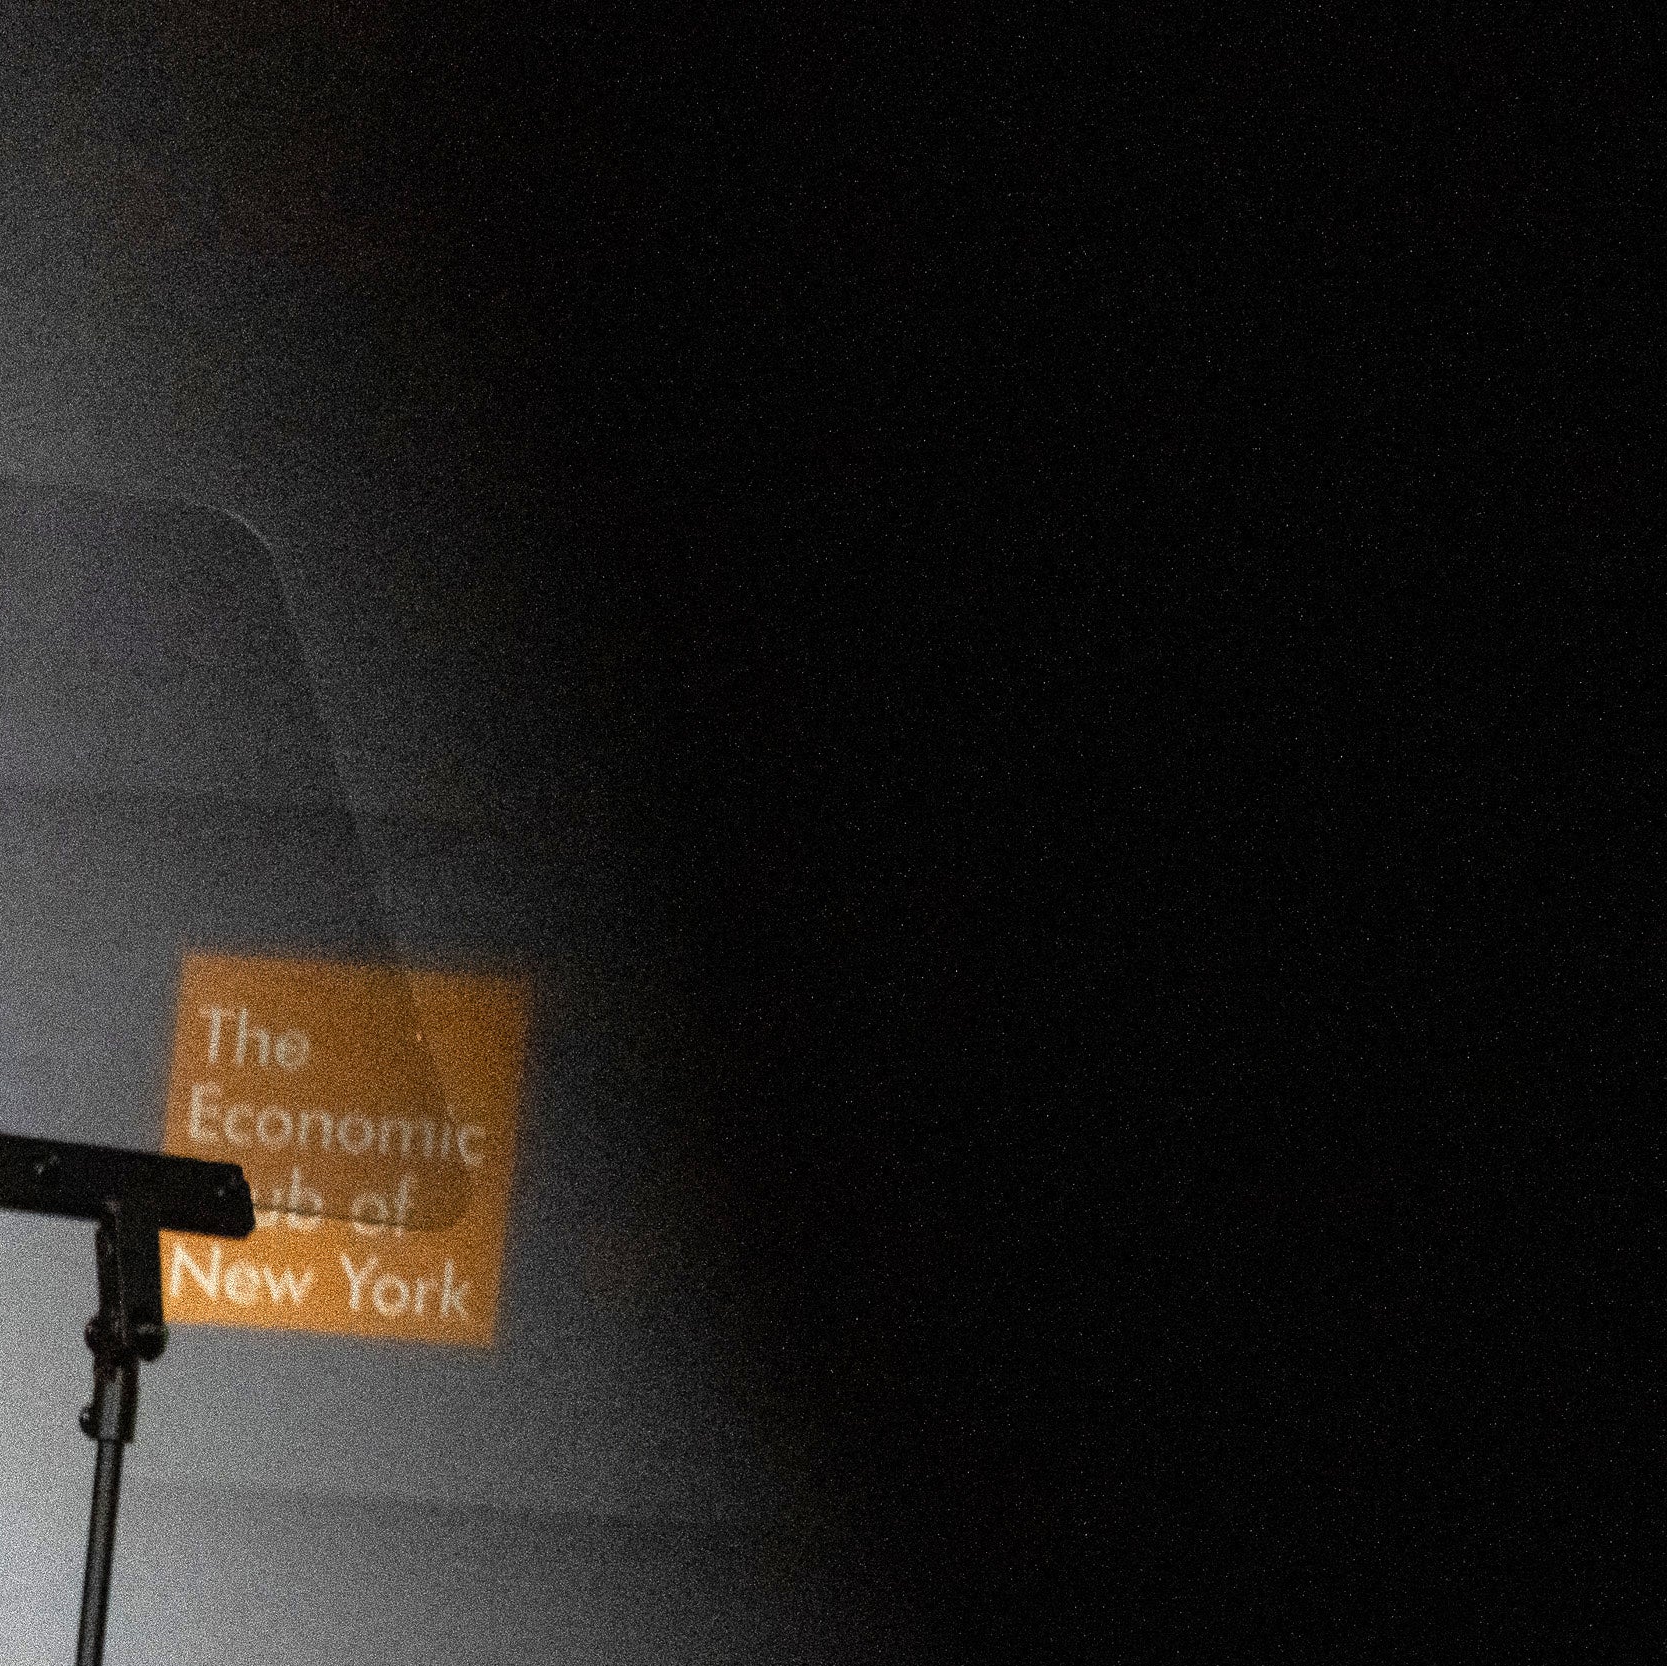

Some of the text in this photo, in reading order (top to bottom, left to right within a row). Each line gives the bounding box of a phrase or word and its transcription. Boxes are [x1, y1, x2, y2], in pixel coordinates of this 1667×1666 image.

[198, 1005, 310, 1071] The
[188, 1082, 485, 1167] Economic
[253, 1166, 415, 1238] ub of
[170, 1244, 469, 1318] New York
